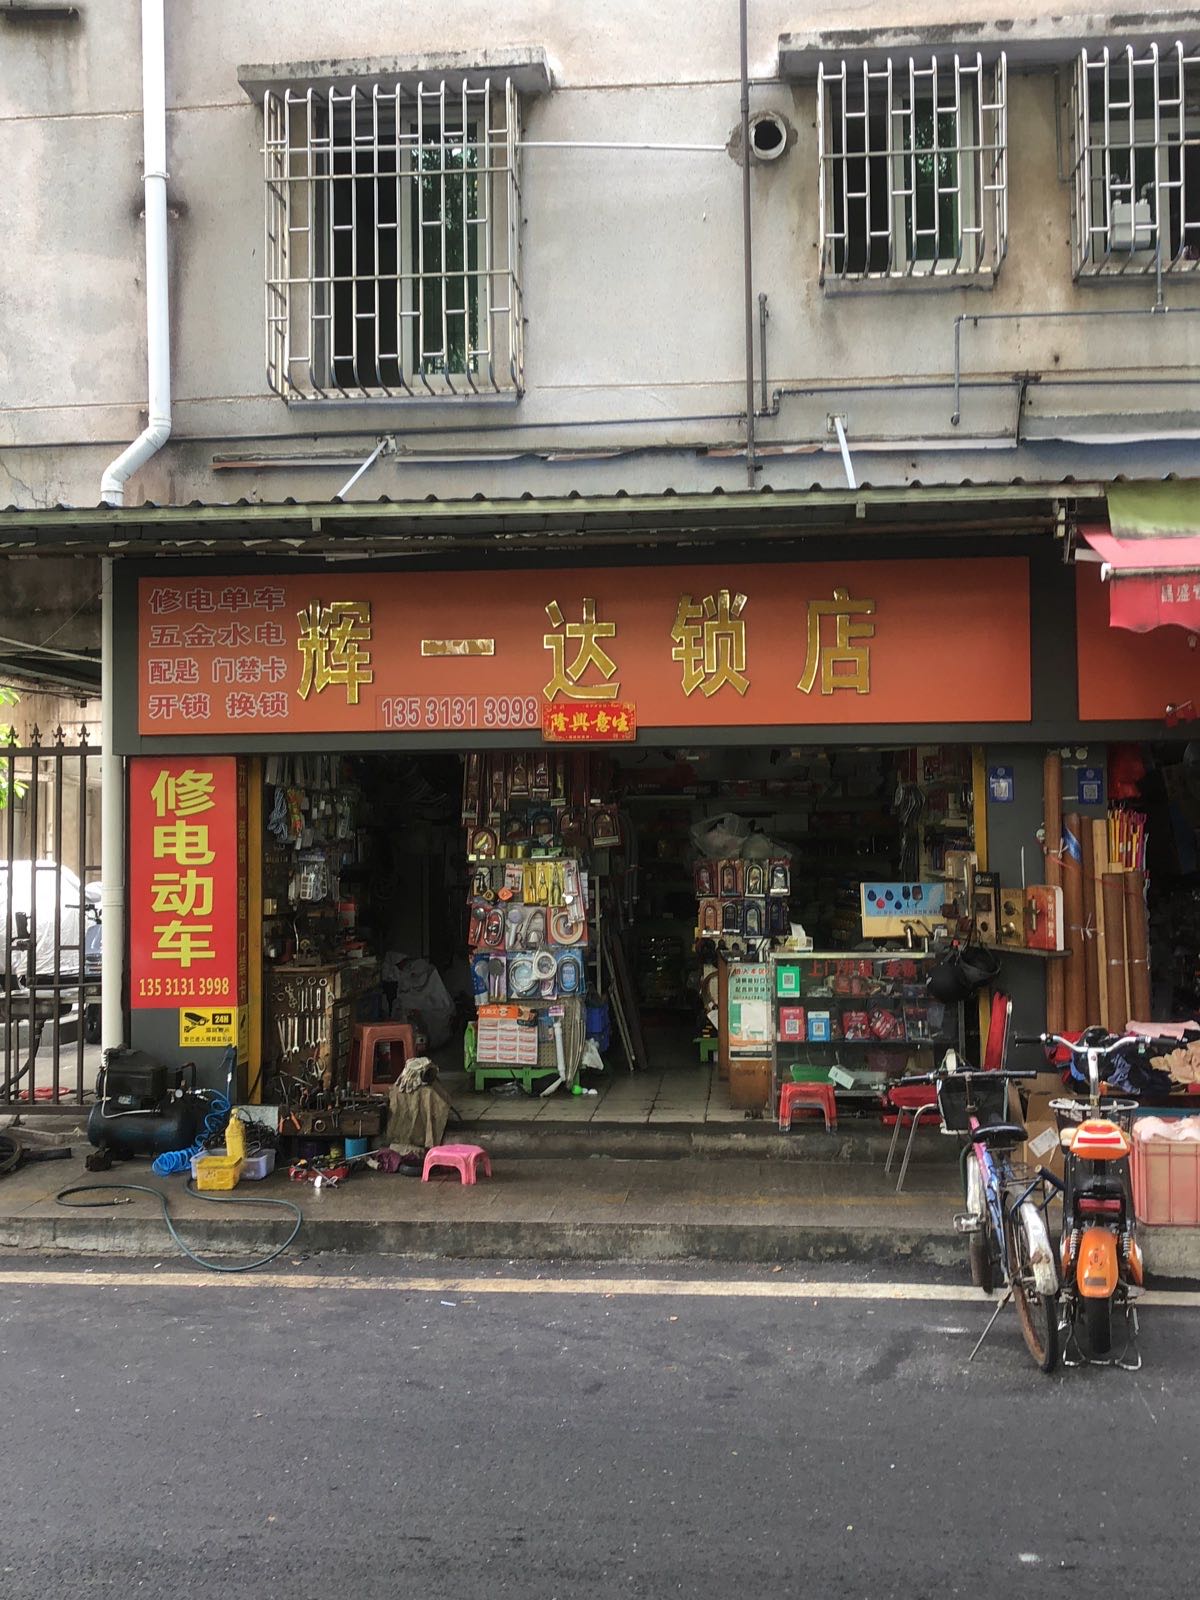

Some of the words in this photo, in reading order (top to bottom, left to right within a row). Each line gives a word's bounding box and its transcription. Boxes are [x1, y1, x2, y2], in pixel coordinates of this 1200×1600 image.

[148, 586, 287, 614] 修电单车
[148, 621, 287, 648] 五金水电
[295, 587, 878, 705] 辉一达锁店
[148, 656, 199, 684] 配匙
[211, 656, 287, 683] 门禁卡
[148, 692, 211, 720] 开锁
[226, 690, 290, 718] 换锁
[380, 697, 421, 728] 135
[425, 696, 478, 727] 3131
[484, 696, 538, 727] 3998
[150, 769, 217, 968] 修电动车
[139, 977, 162, 997] 135
[165, 976, 195, 997] 3131
[199, 976, 230, 996] 3998
[214, 1014, 229, 1024] 24H
